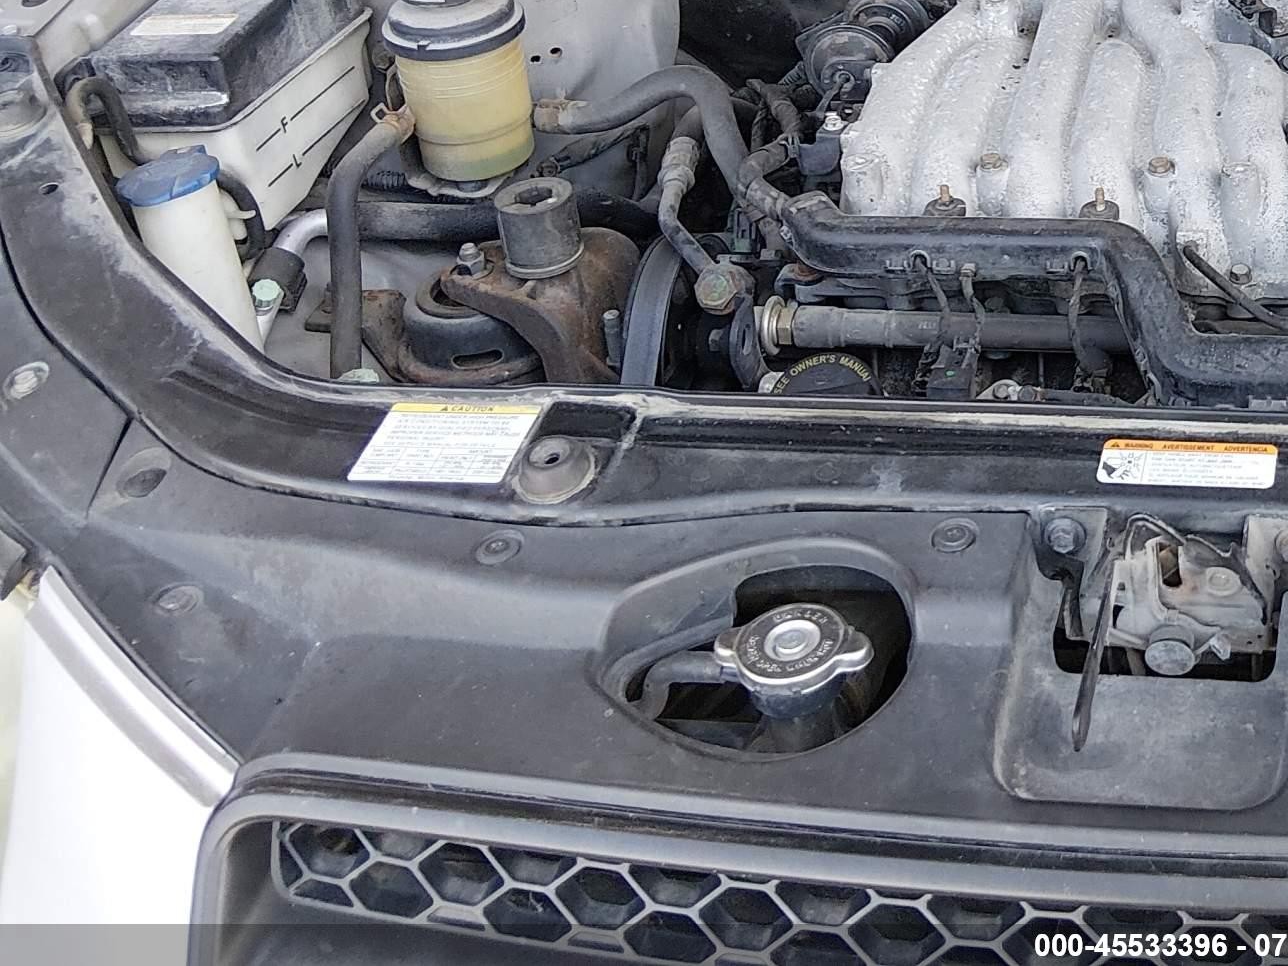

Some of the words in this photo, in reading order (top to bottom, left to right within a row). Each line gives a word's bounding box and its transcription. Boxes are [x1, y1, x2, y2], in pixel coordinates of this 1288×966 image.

[281, 116, 289, 133] F
[293, 154, 302, 168] L
[773, 376, 790, 395] SEE
[790, 354, 837, 377] OWNER'S
